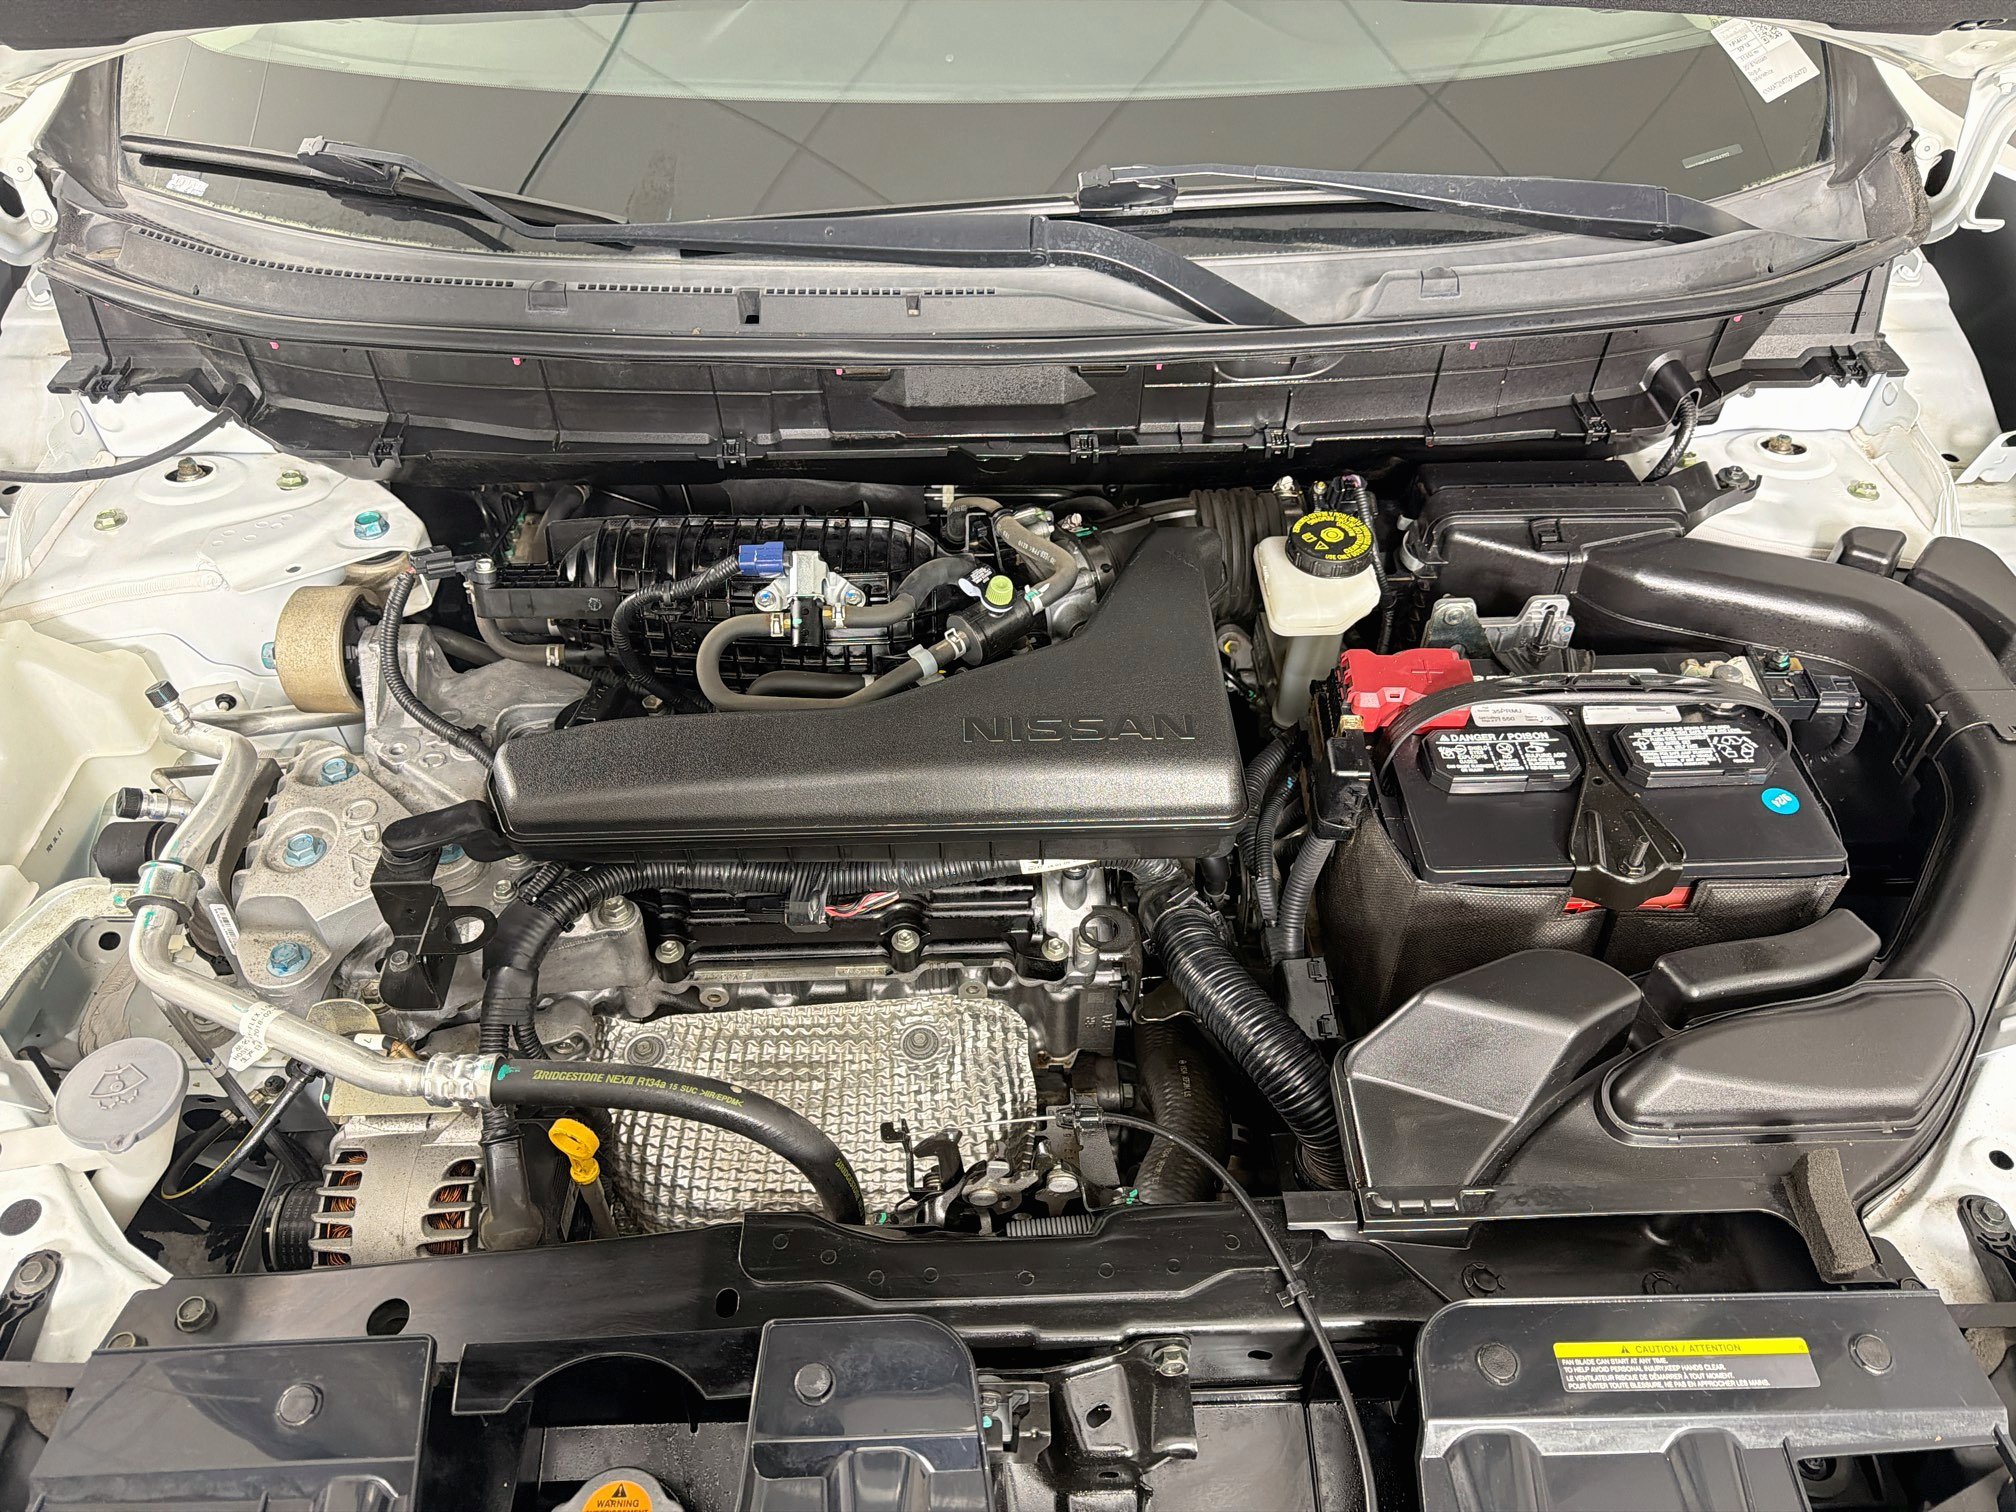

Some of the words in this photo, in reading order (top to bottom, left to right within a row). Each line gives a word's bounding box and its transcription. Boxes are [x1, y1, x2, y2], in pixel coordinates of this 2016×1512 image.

[1336, 552, 1352, 560] ONLY
[962, 715, 1196, 743] NISSAN
[1450, 733, 1497, 742] DANGER
[1508, 732, 1550, 740] POISON
[1771, 793, 1793, 808] 9/24
[532, 1069, 603, 1083] BRIDGESTONE
[636, 1076, 667, 1089] R134a
[668, 1083, 678, 1091] 15
[680, 1084, 698, 1095] SUC
[1635, 1345, 1679, 1354] CAUTION
[1689, 1344, 1742, 1352] ATTENTION
[1561, 1358, 1574, 1366] FAN
[1610, 1365, 1644, 1373] PERSONAL
[1574, 1374, 1615, 1382] VENTILATEUR
[1639, 1373, 1650, 1381] DE
[1736, 1379, 1749, 1387] LES
[596, 1499, 640, 1508] WARNING
